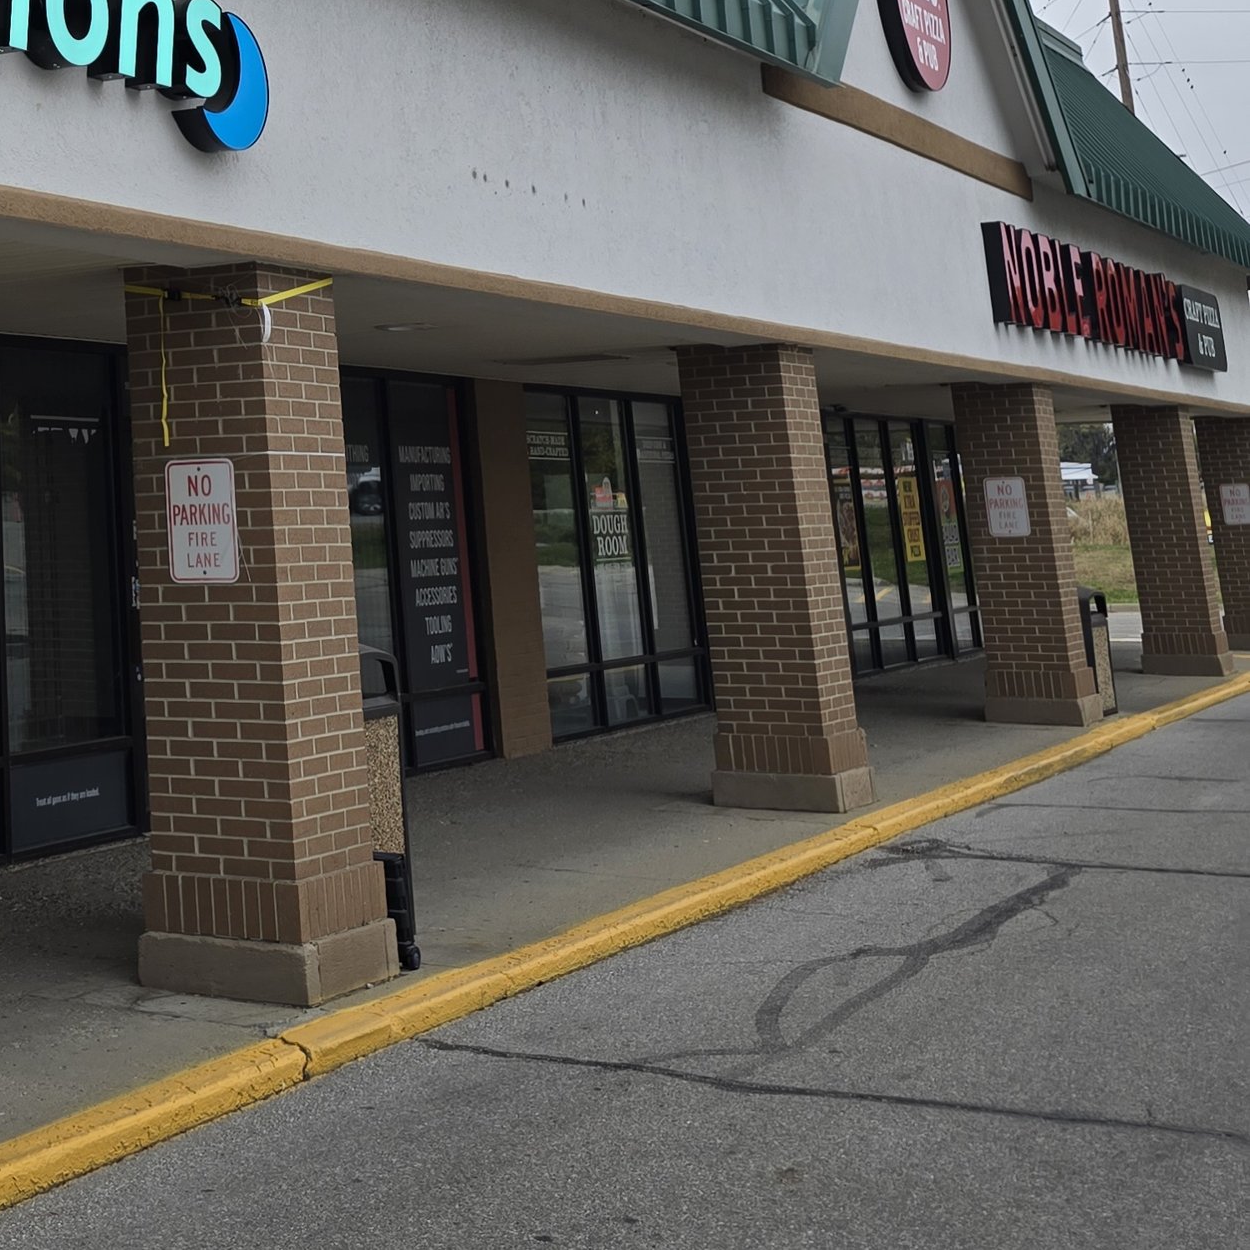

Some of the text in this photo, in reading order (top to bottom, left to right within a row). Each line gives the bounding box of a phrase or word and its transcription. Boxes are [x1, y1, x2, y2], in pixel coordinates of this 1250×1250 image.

[924, 6, 946, 46] PIZZA
[916, 36, 939, 72] & PUB
[999, 221, 1184, 361] NOBLE ROMAN'S
[1183, 297, 1220, 329] CRAFT PIZZA
[1204, 336, 1216, 358] PUB
[346, 444, 369, 463] THING
[398, 445, 451, 464] MANUFACTURING
[187, 474, 212, 497] NO
[409, 473, 445, 492] IMPORTING
[997, 484, 1013, 496] NO
[1230, 489, 1241, 497] NO
[172, 502, 231, 526] PARKING
[408, 501, 450, 520] CUSTOM AR'S
[989, 498, 1024, 510] PARKING
[592, 514, 629, 535] DOUGH
[188, 531, 217, 547] FIRE
[409, 530, 454, 549] SUPPRESSORS
[596, 535, 628, 556] ROOM
[187, 552, 221, 568] LANE
[410, 558, 439, 578] MACHINE
[415, 585, 457, 606] ACCESSORIES
[425, 614, 452, 635] TOOLING
